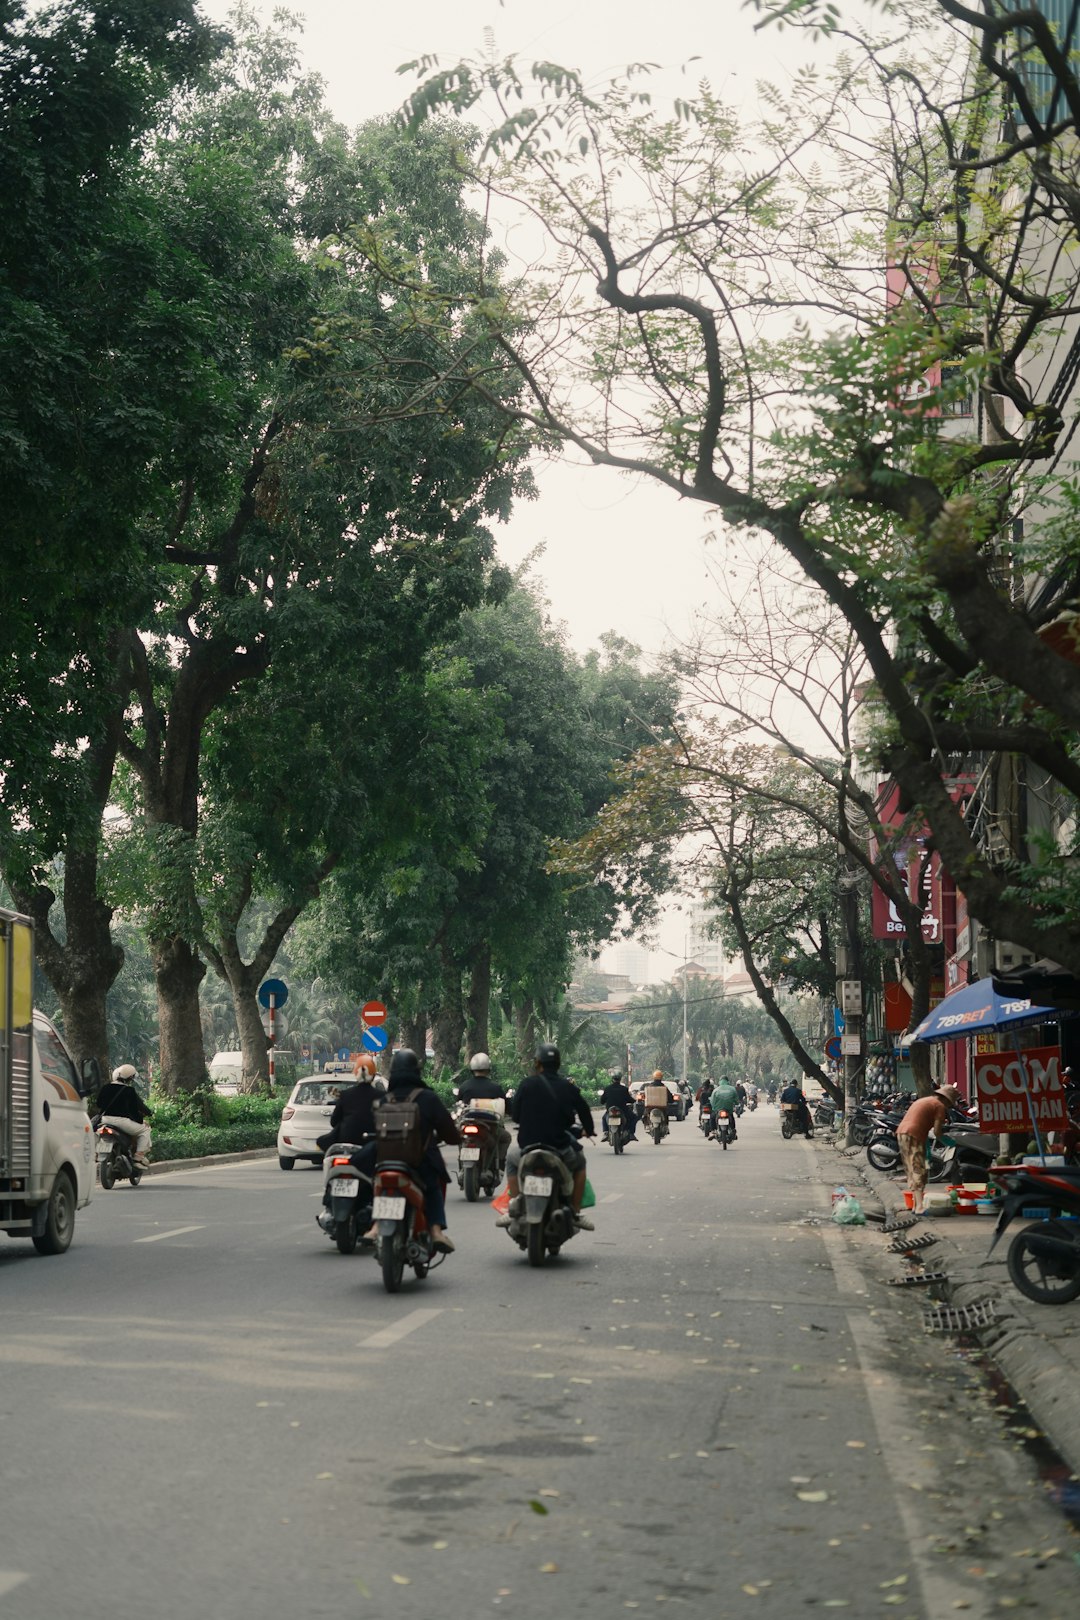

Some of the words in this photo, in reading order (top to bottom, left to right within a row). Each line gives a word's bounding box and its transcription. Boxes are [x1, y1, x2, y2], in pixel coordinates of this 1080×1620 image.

[936, 1008, 988, 1029] 789BET
[977, 1054, 1062, 1095] CƠM
[982, 1099, 1023, 1122] BÌNH
